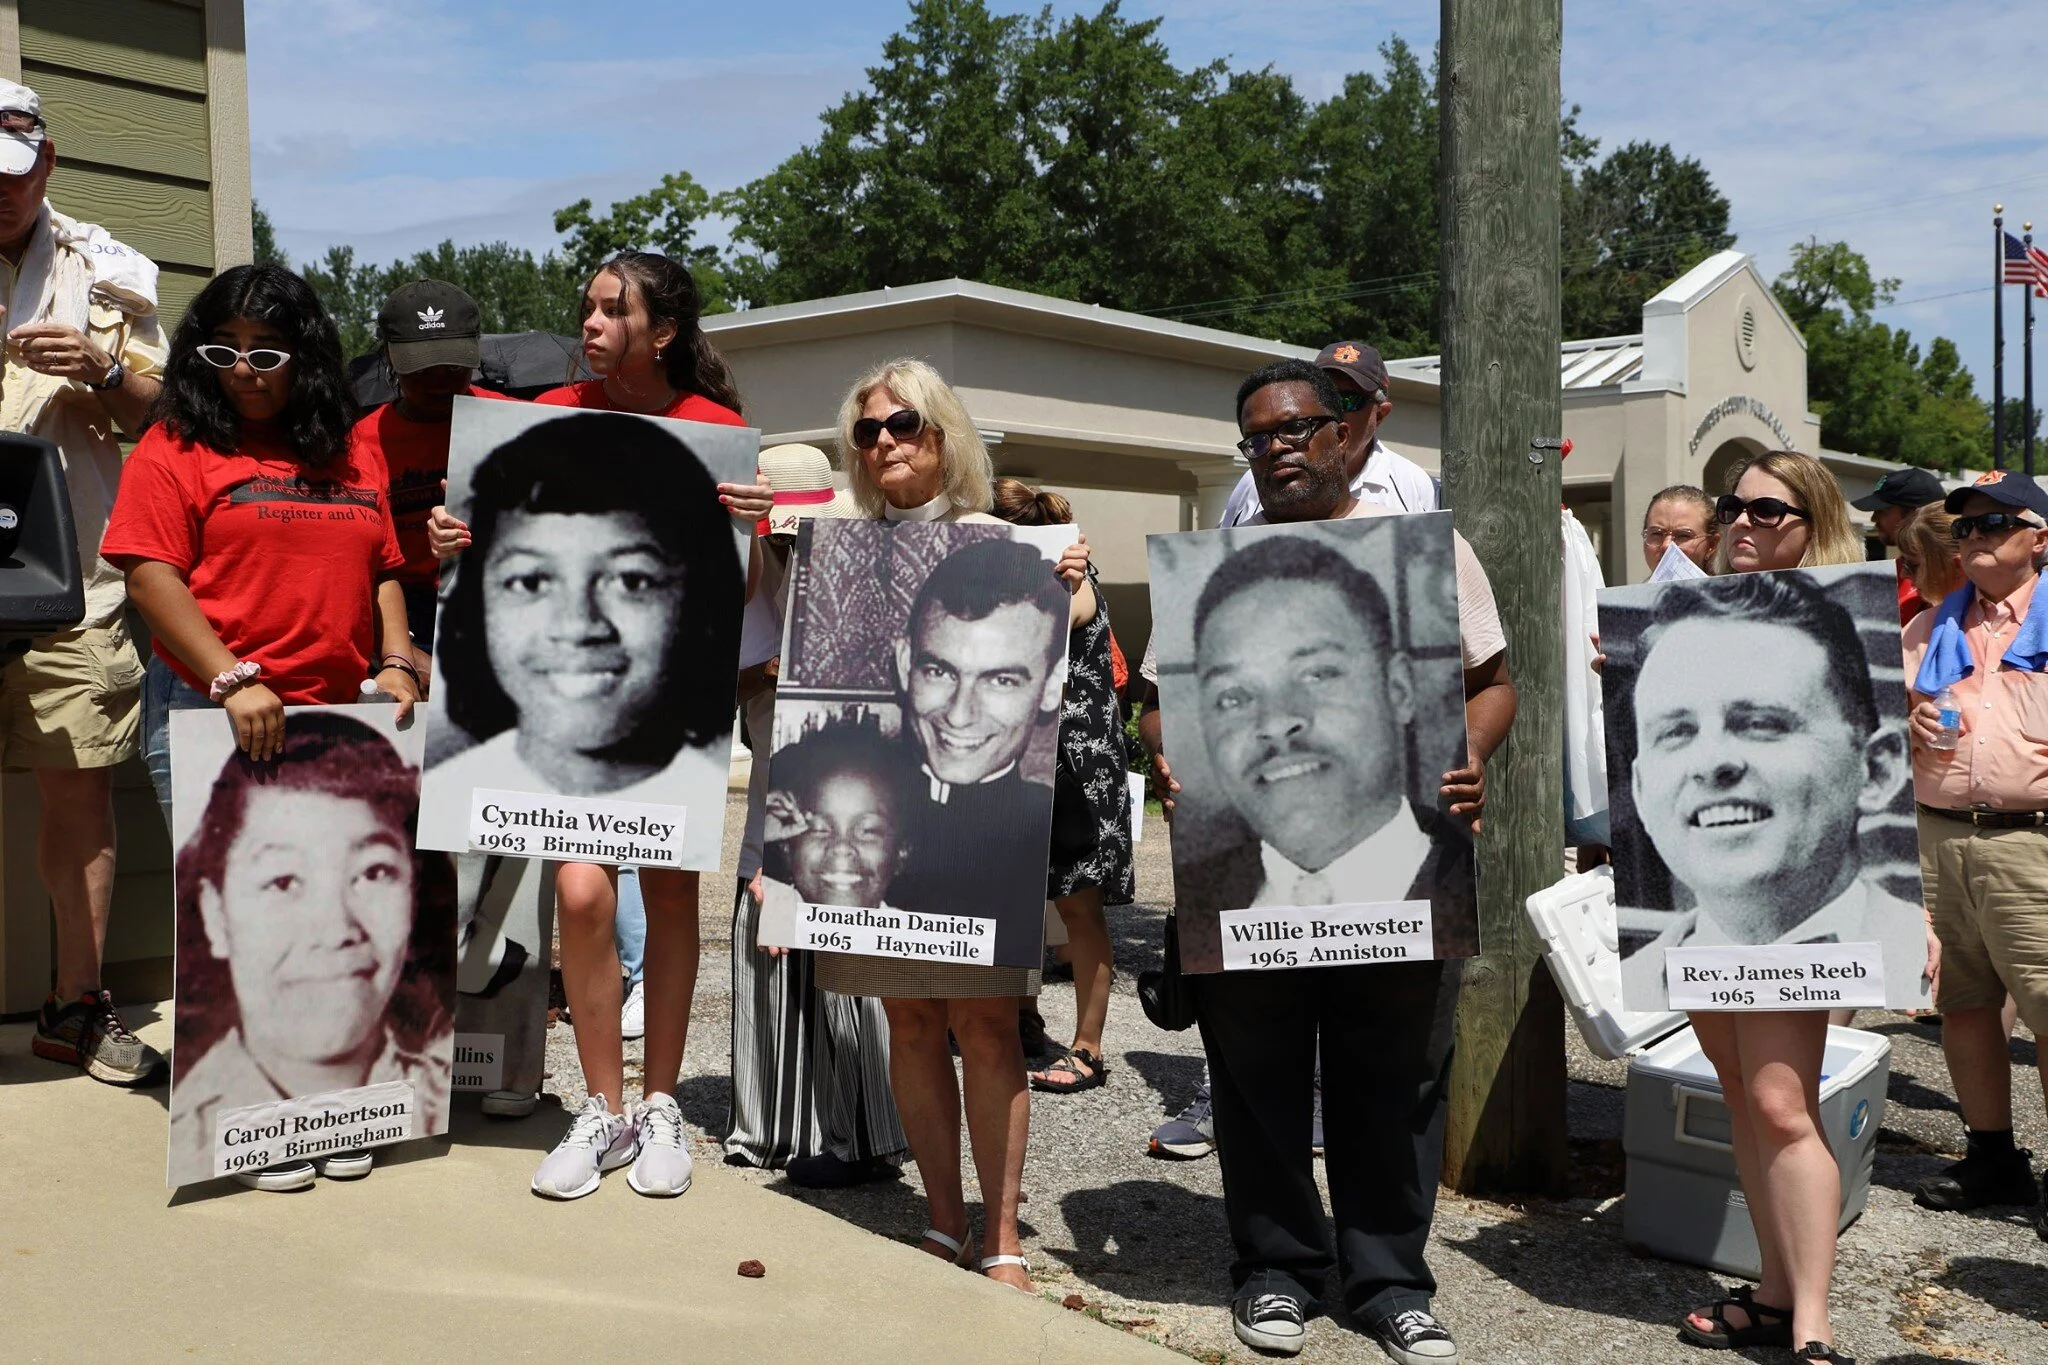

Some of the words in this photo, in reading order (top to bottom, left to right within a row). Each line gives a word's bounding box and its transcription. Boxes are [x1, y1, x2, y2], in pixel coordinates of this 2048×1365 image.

[418, 322, 446, 330] adidas
[257, 505, 323, 524] Register
[328, 507, 355, 521] and
[481, 804, 579, 830] Cynthia
[585, 813, 675, 842] Wesley
[478, 832, 526, 852] 1963
[543, 835, 673, 861] Birmingham
[806, 907, 900, 929] Jonathan
[907, 914, 985, 936] Daniels
[1229, 921, 1304, 942] Willie
[1310, 918, 1424, 939] Brewster
[808, 932, 852, 951] 1965
[876, 935, 980, 959] Hayneville
[1249, 948, 1298, 968] 1965
[1308, 943, 1407, 962] Anniston
[1682, 966, 1728, 982] Rev.
[1734, 965, 1804, 981] James
[1810, 961, 1867, 979] Reeb
[1710, 988, 1755, 1006] 1965
[1779, 986, 1841, 1002] Selma
[454, 1047, 494, 1064] llins
[224, 1119, 286, 1147] Carol
[292, 1102, 406, 1134] Robertson
[224, 1150, 270, 1171] 1963
[284, 1126, 403, 1158] Birmingham
